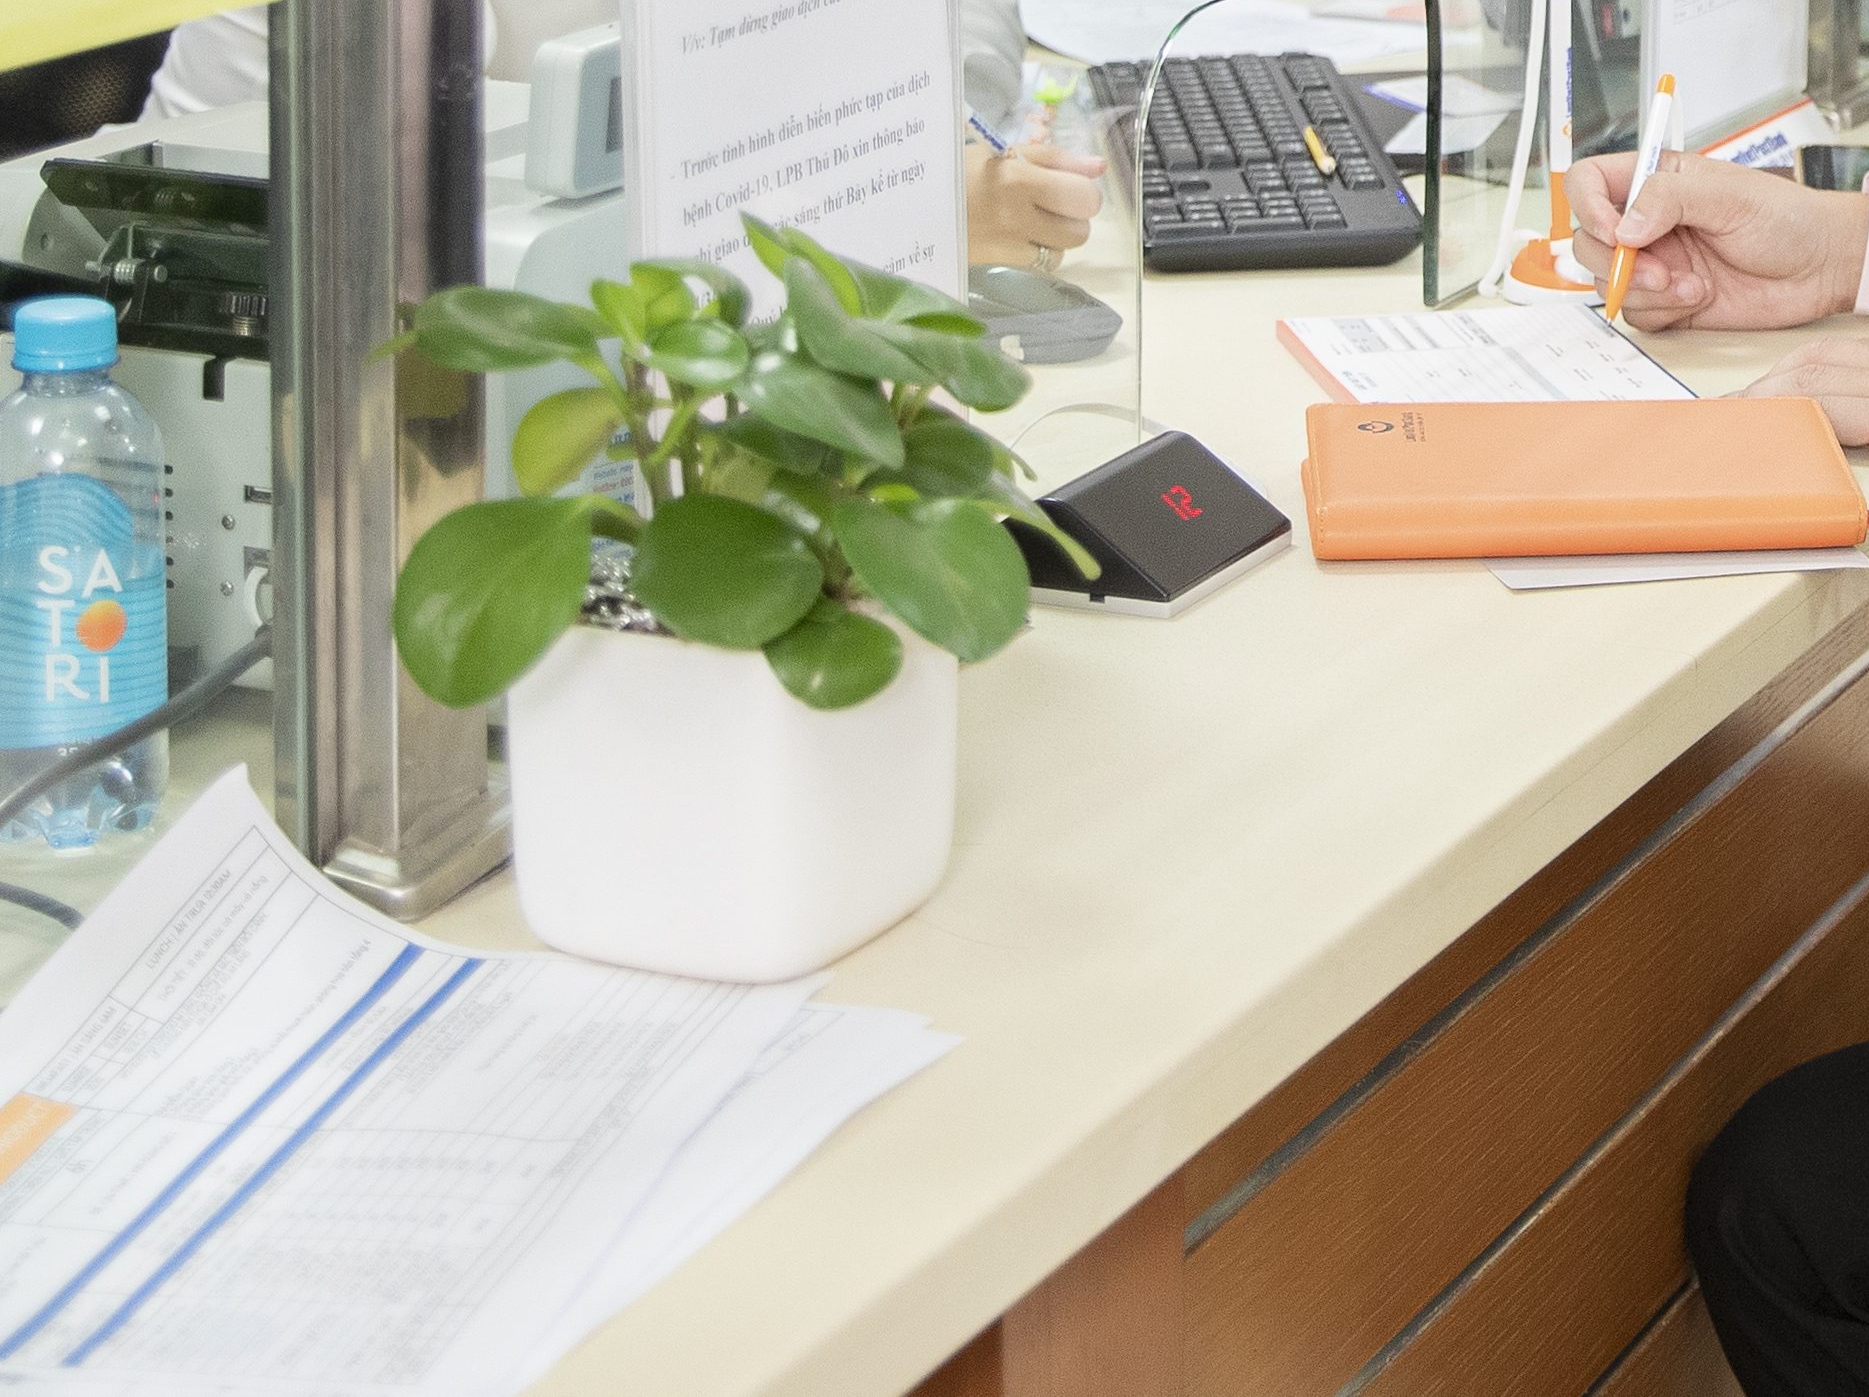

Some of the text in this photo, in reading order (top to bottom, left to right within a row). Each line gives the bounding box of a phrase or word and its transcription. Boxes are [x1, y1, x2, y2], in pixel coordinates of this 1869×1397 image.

[709, 25, 736, 49] Tạm
[771, 4, 795, 30] giao
[722, 140, 745, 164] tình
[748, 128, 775, 154] hình
[806, 103, 832, 131] biến
[865, 91, 884, 112] tạp
[886, 81, 906, 101] của
[908, 70, 930, 96] dịch
[683, 198, 712, 227] bệnh
[715, 174, 773, 213] Covid-19,
[776, 162, 803, 189] LPB
[833, 143, 850, 166] Đô
[852, 139, 870, 159] xin
[872, 128, 904, 151] thông
[905, 117, 926, 137] báo
[714, 238, 740, 265] giao
[794, 205, 820, 227] sáng
[823, 192, 844, 215] thứ
[846, 183, 868, 205] Bảy
[871, 168, 885, 195] kể
[887, 168, 899, 189] từ
[901, 160, 926, 185] ngày
[908, 241, 921, 265] về
[922, 243, 936, 263] sự
